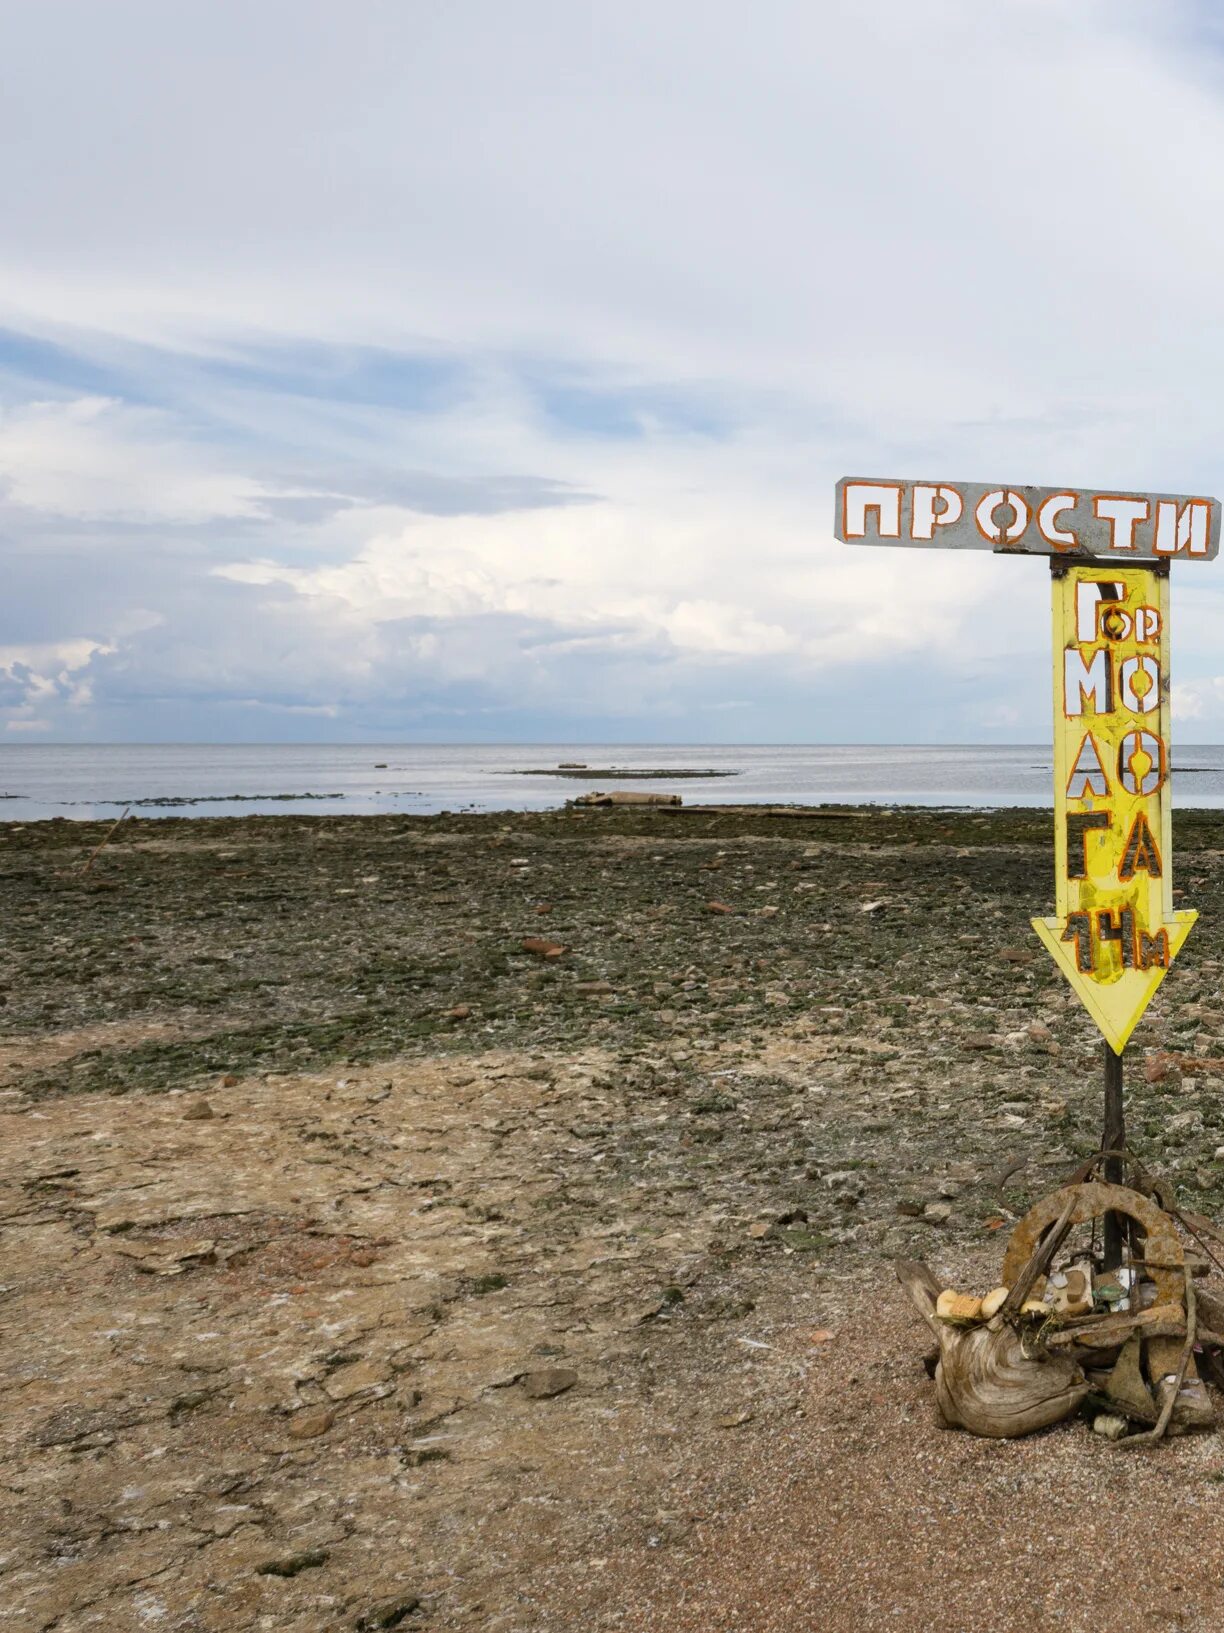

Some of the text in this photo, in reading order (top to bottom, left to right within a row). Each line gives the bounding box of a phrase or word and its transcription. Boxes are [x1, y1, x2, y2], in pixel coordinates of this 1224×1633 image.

[843, 481, 1211, 557] ПРОСТИ
[1063, 647, 1162, 720] МО
[1066, 728, 1166, 799] ЛО
[1066, 810, 1163, 883] ГА
